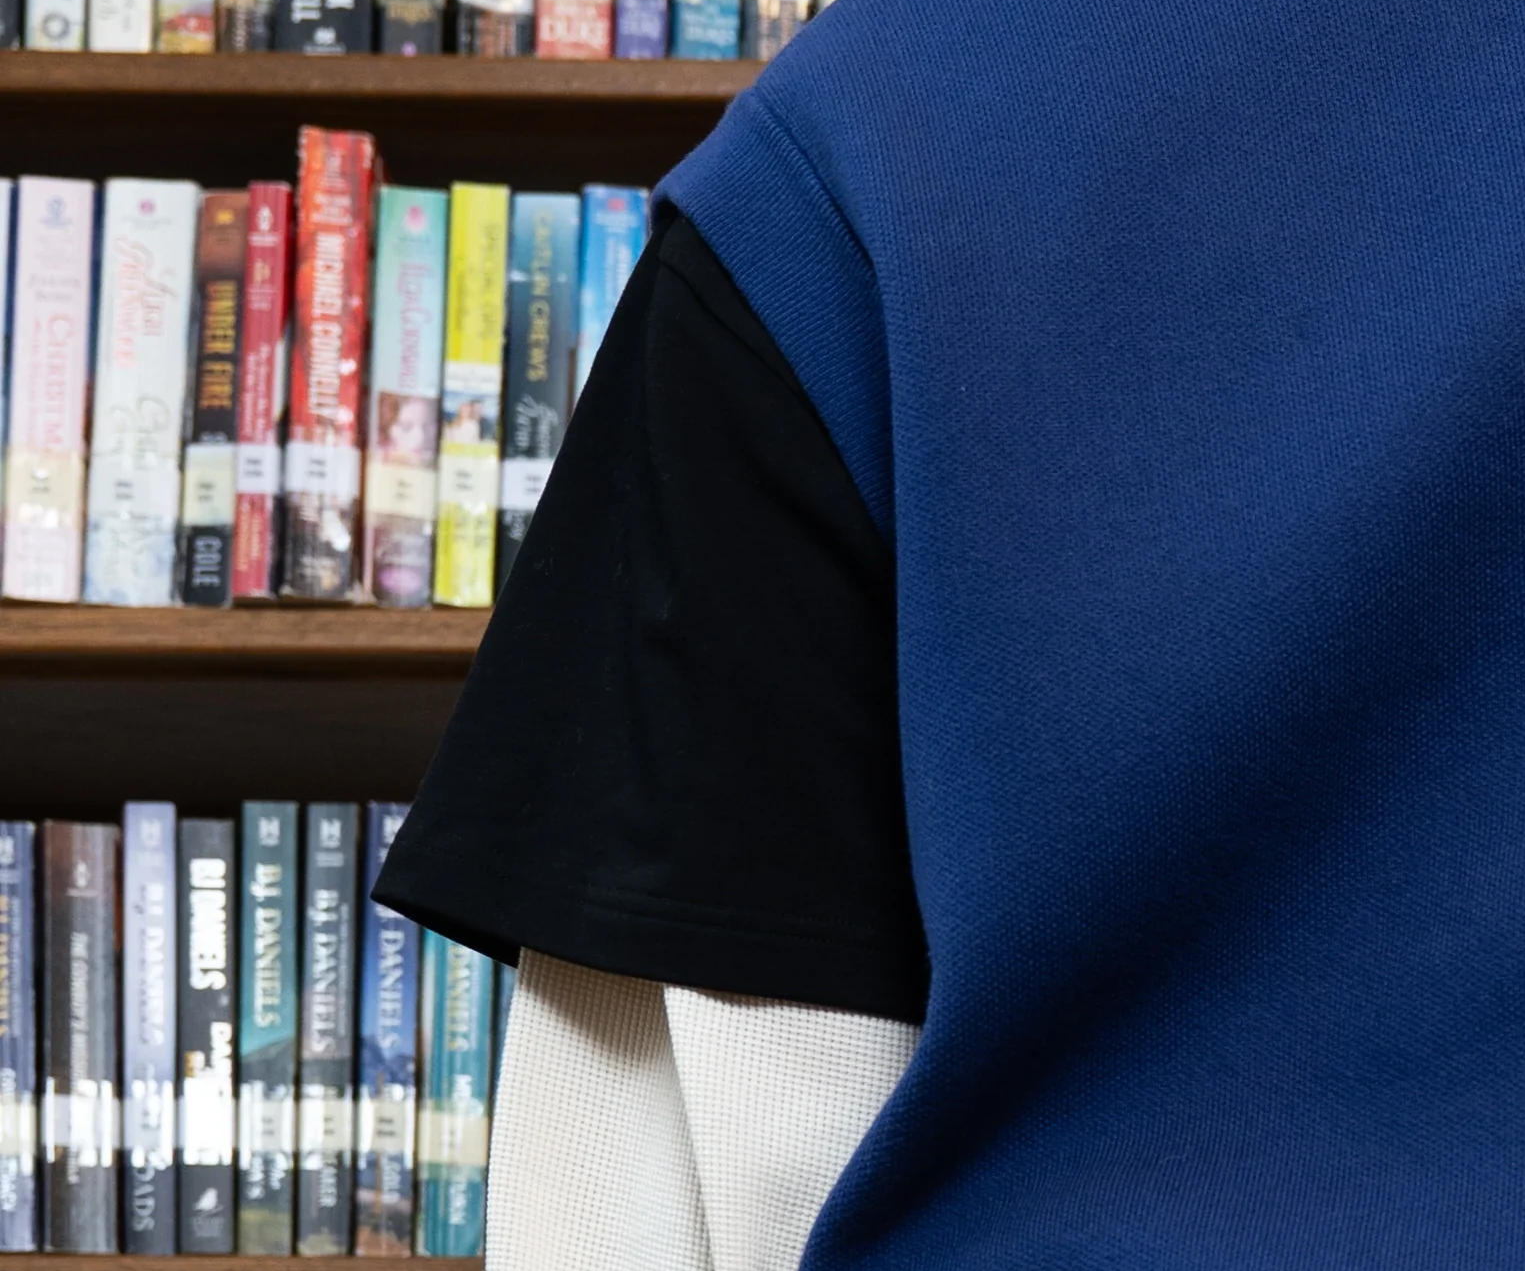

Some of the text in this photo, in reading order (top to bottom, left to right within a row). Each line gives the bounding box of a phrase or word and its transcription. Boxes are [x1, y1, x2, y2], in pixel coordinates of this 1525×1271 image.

[200, 280, 237, 410] UNDER FIRE
[309, 233, 344, 424] MICHAEL CONNELLY
[525, 212, 553, 382] CAITLIN CREWS
[194, 536, 222, 587] COLE
[253, 906, 281, 1028] DANIELS
[311, 931, 339, 1053] DANIELS
[378, 928, 406, 1045] DANIELS
[447, 942, 471, 1052] DANIELS
